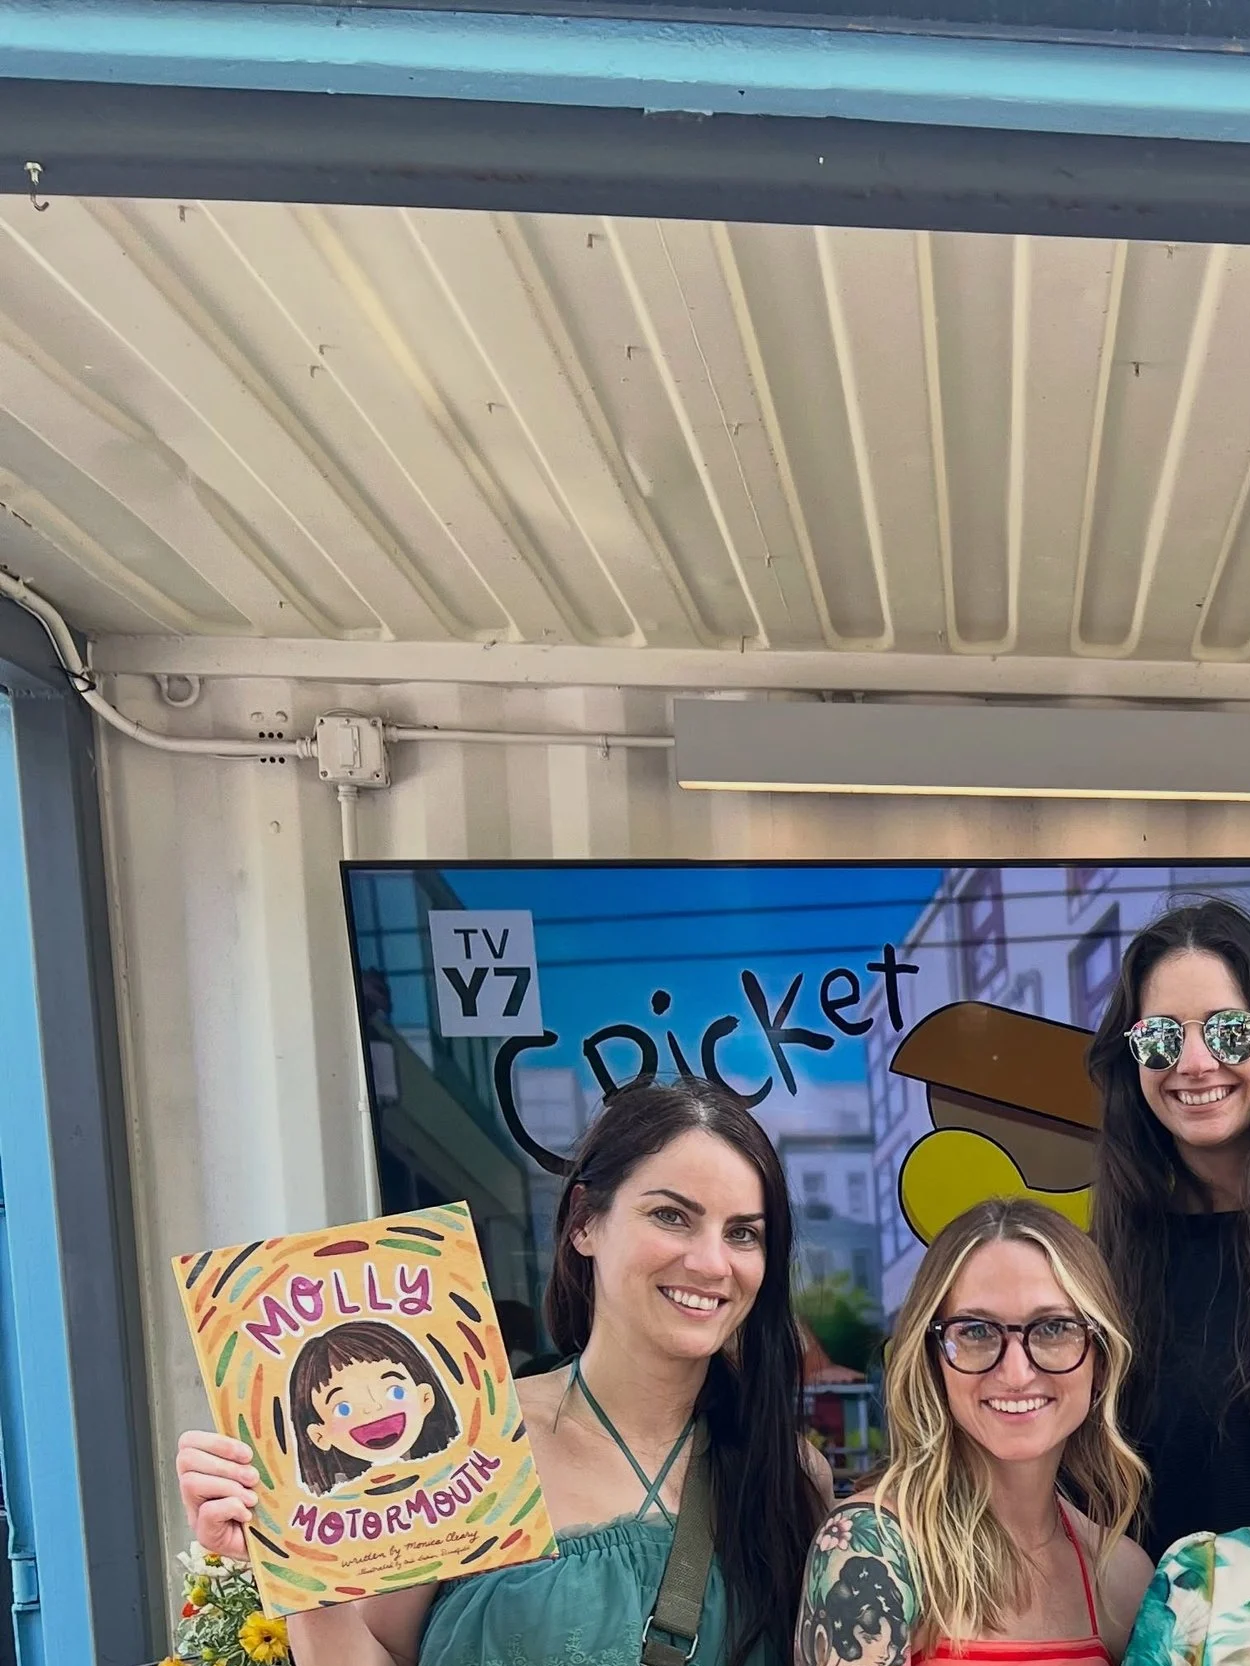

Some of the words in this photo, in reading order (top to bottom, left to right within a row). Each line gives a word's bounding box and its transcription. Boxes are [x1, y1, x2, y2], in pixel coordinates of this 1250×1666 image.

[453, 928, 509, 959] TV
[441, 967, 532, 1018] Y7
[245, 1264, 432, 1355] MOLLY
[292, 1449, 500, 1544] MOTORMOUTH
[389, 1545, 401, 1560] by
